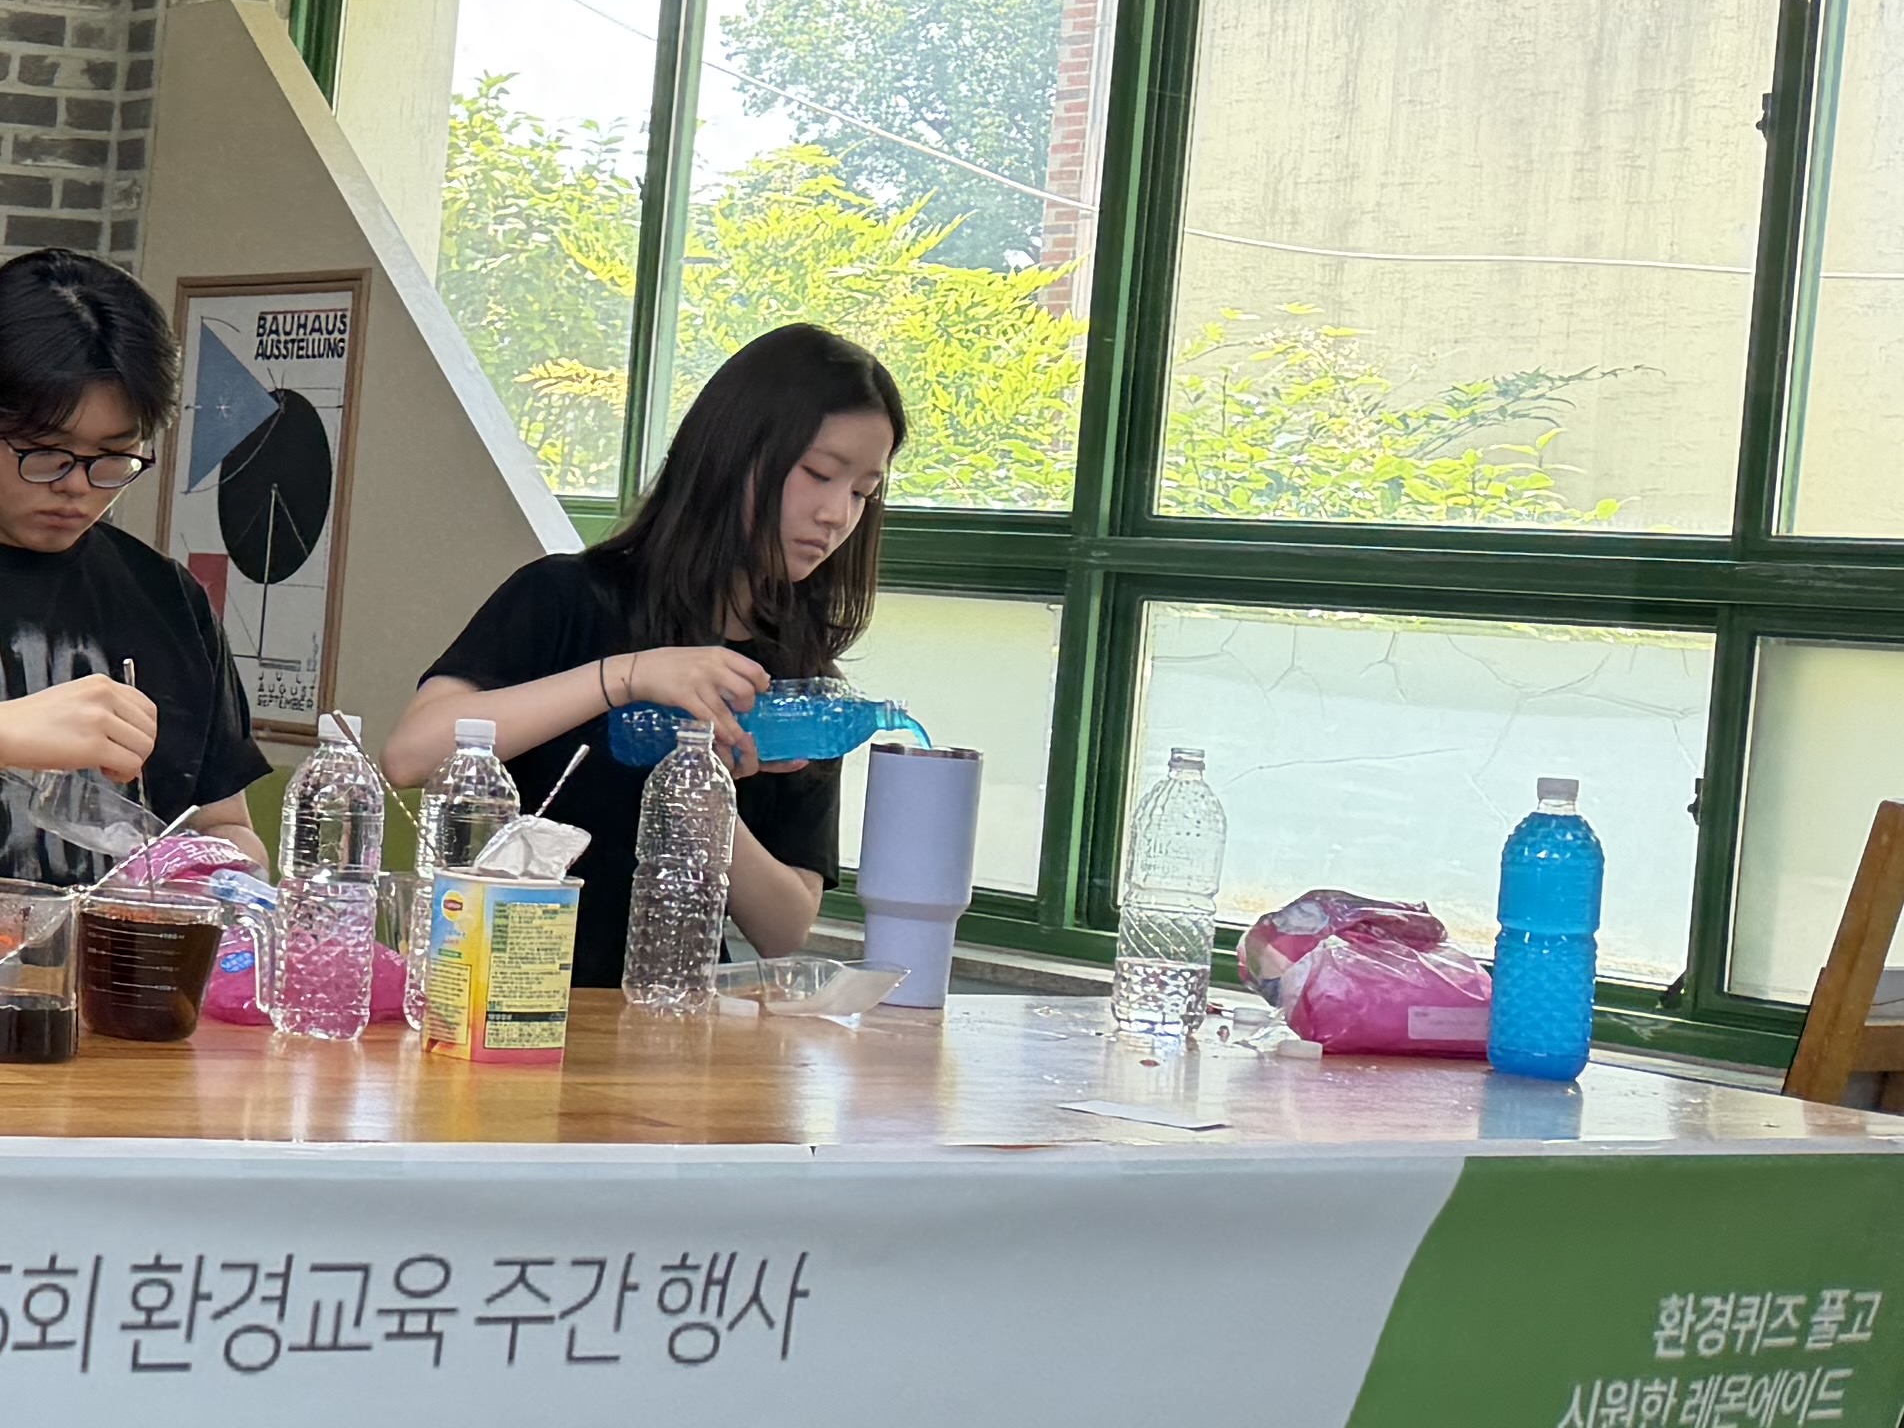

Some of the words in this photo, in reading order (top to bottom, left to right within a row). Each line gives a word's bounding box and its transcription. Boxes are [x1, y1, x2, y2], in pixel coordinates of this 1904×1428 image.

[254, 337, 346, 361] AUSSTELLUNG
[256, 313, 348, 339] BAUHAUS
[118, 1252, 459, 1376] 환경교육
[474, 1251, 641, 1368] 주간
[655, 1250, 811, 1367] 행사
[1652, 1290, 1807, 1360] 환경퀴즈
[1804, 1288, 1883, 1350] 풀고
